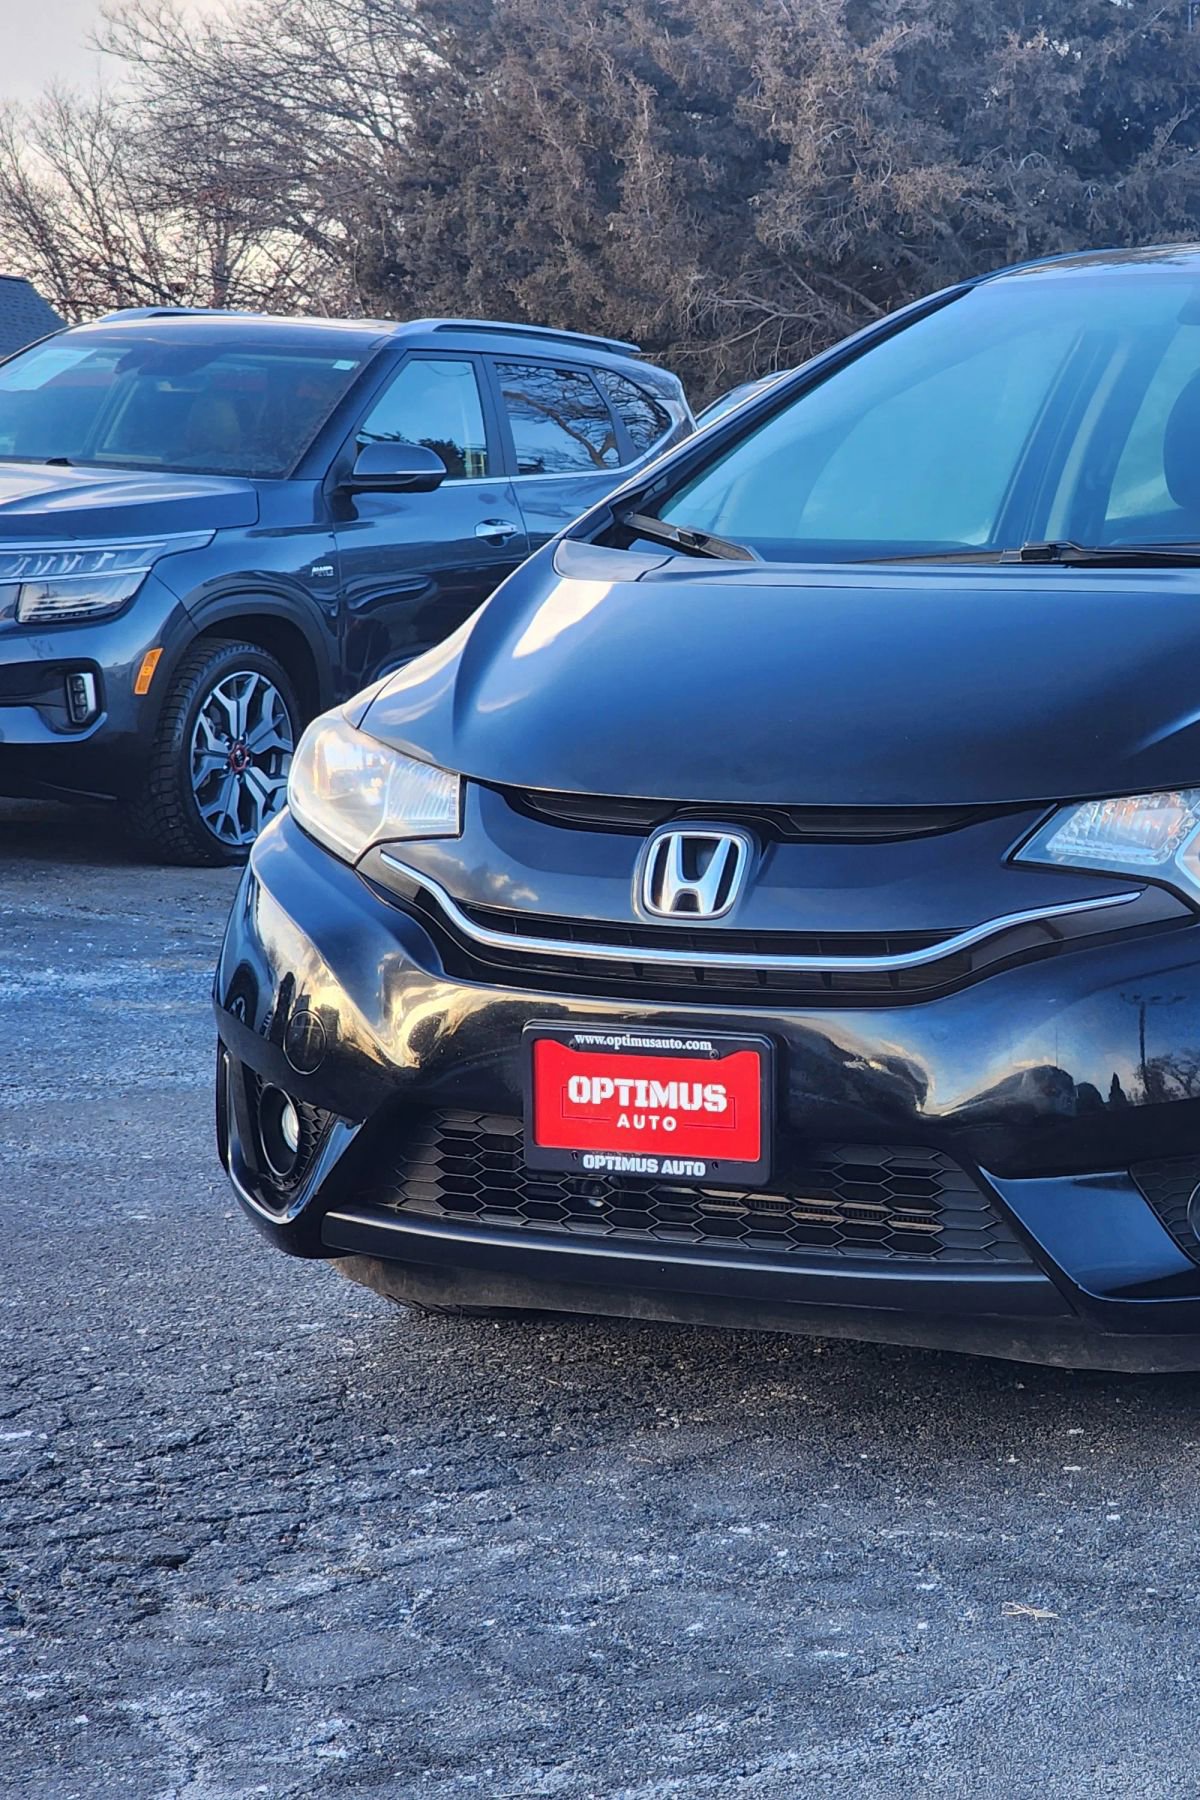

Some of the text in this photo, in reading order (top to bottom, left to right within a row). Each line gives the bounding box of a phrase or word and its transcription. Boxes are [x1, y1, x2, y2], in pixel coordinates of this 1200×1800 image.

[574, 1034, 712, 1051] www.optimusauto.com
[567, 1075, 728, 1113] OPTIMUS
[616, 1113, 677, 1132] AUTO
[583, 1154, 706, 1177] OPTIMUS AUTO
